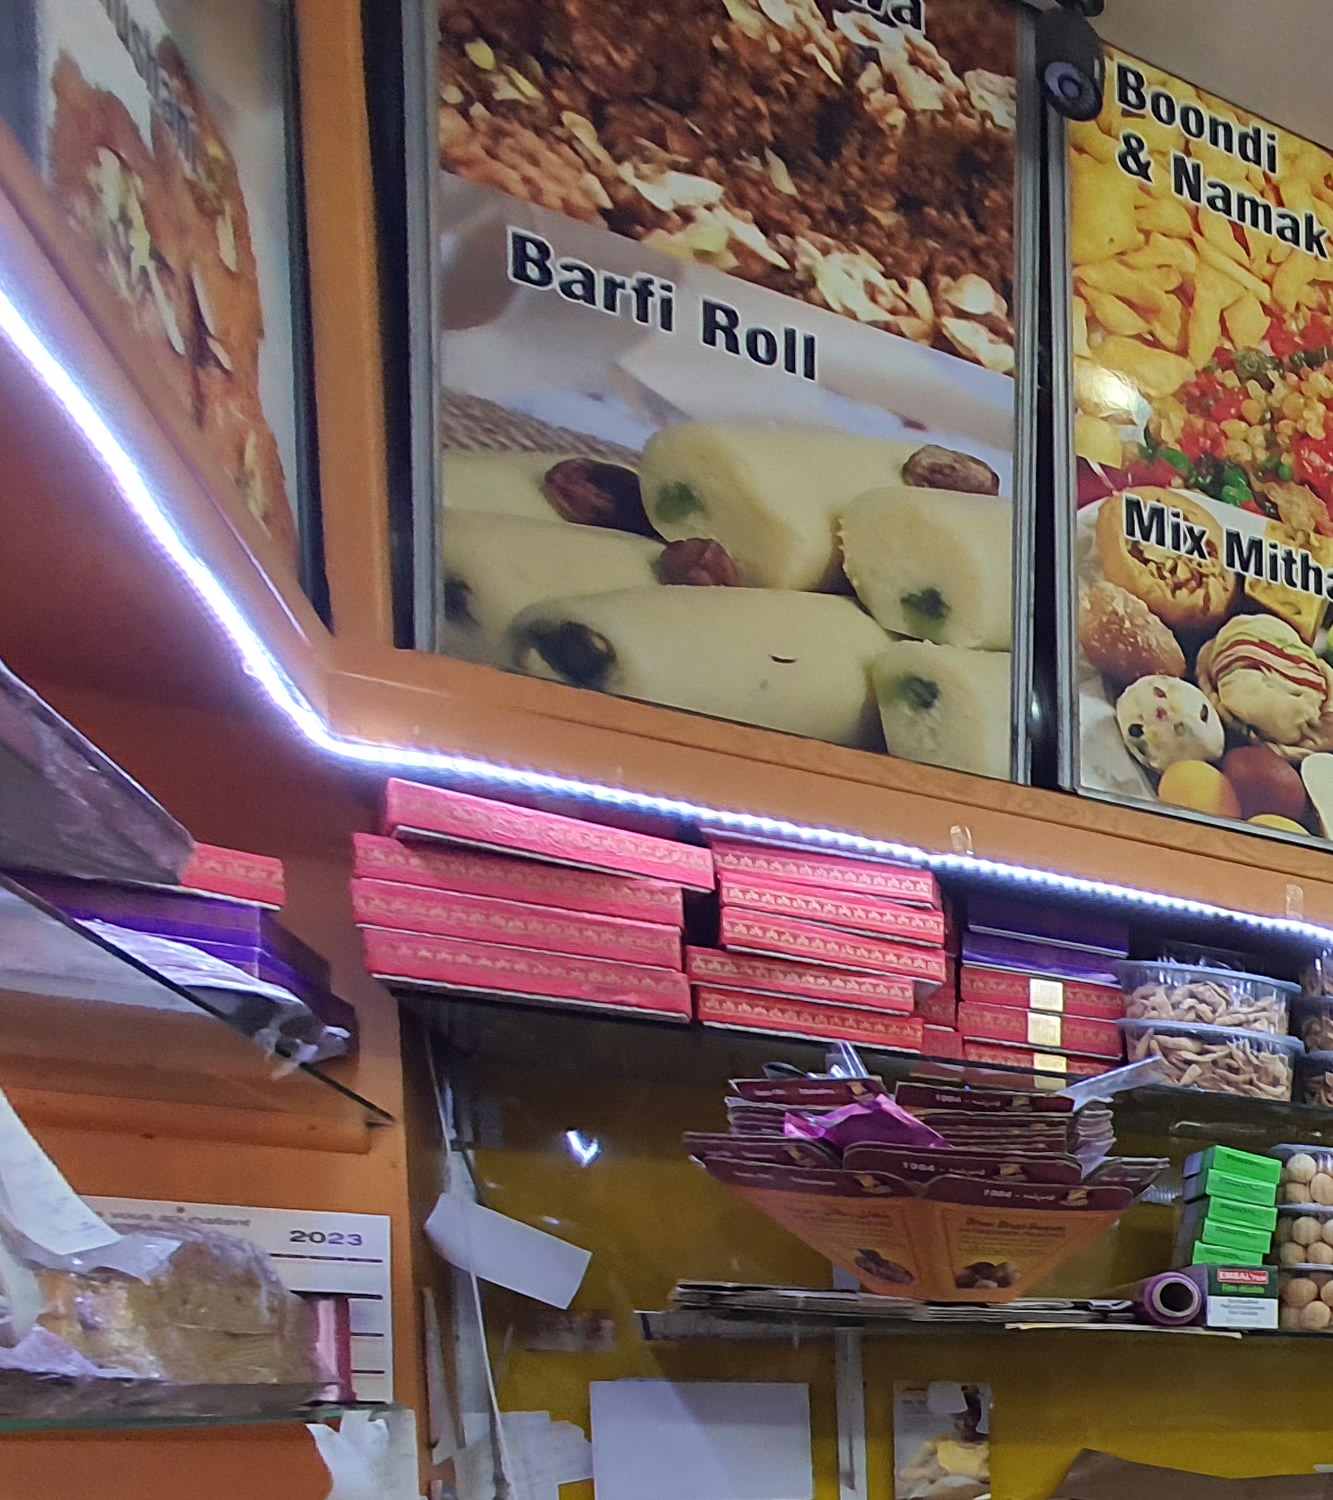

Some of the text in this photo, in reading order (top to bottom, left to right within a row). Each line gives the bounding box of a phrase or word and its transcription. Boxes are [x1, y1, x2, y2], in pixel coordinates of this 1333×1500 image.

[1114, 62, 1279, 176] Boondi
[1116, 132, 1154, 184] &
[1172, 153, 1329, 259] Namak
[509, 229, 818, 382] Barfi Roll
[1123, 493, 1211, 560] Mix
[289, 1229, 363, 1247] 2023
